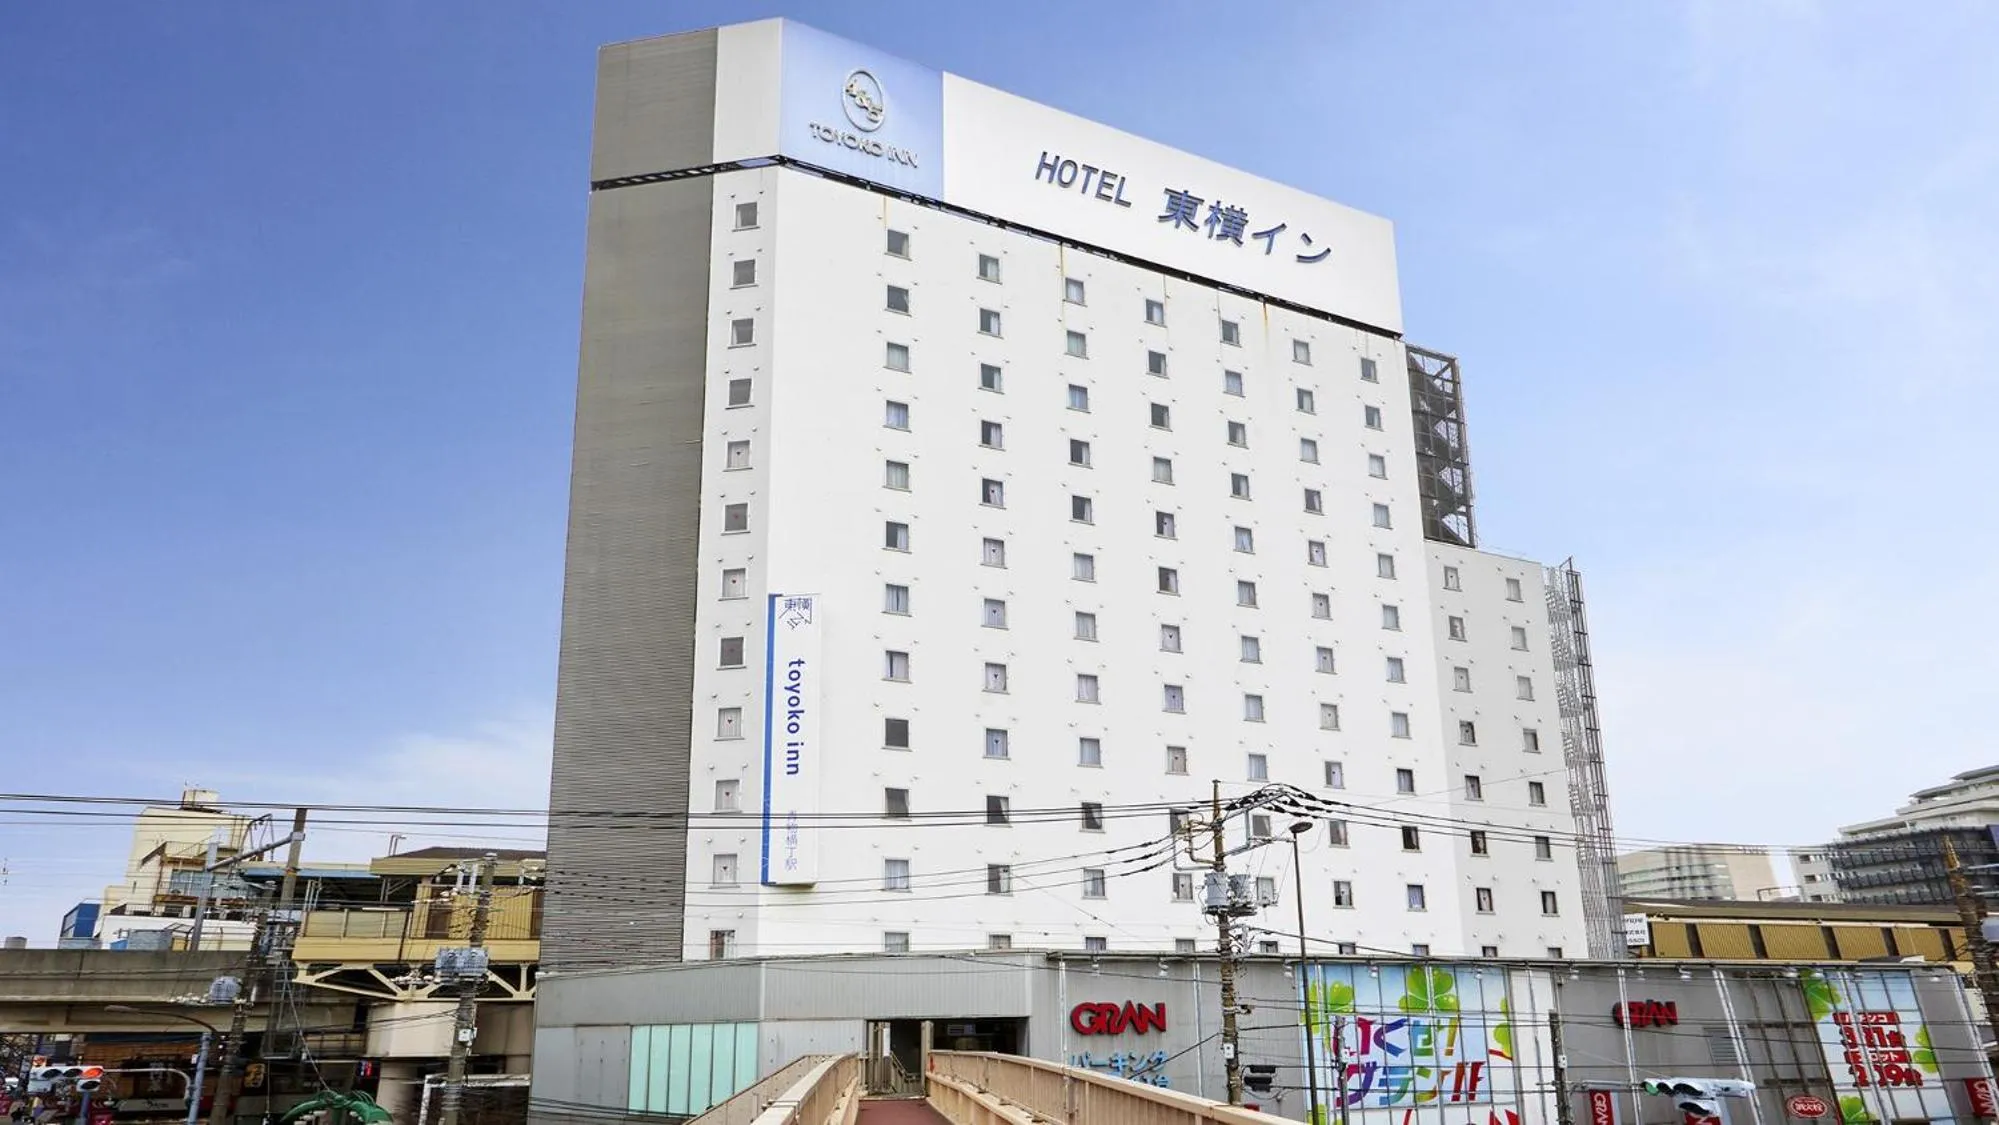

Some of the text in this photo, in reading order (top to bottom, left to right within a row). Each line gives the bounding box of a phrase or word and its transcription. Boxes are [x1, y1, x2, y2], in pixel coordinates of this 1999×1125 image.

[809, 122, 918, 169] TOYOKO INN
[1035, 151, 1133, 208] HOTEL
[1158, 189, 1332, 264] 東横イン
[784, 658, 806, 776] toyoko inn
[1070, 1000, 1167, 1035] GRAN
